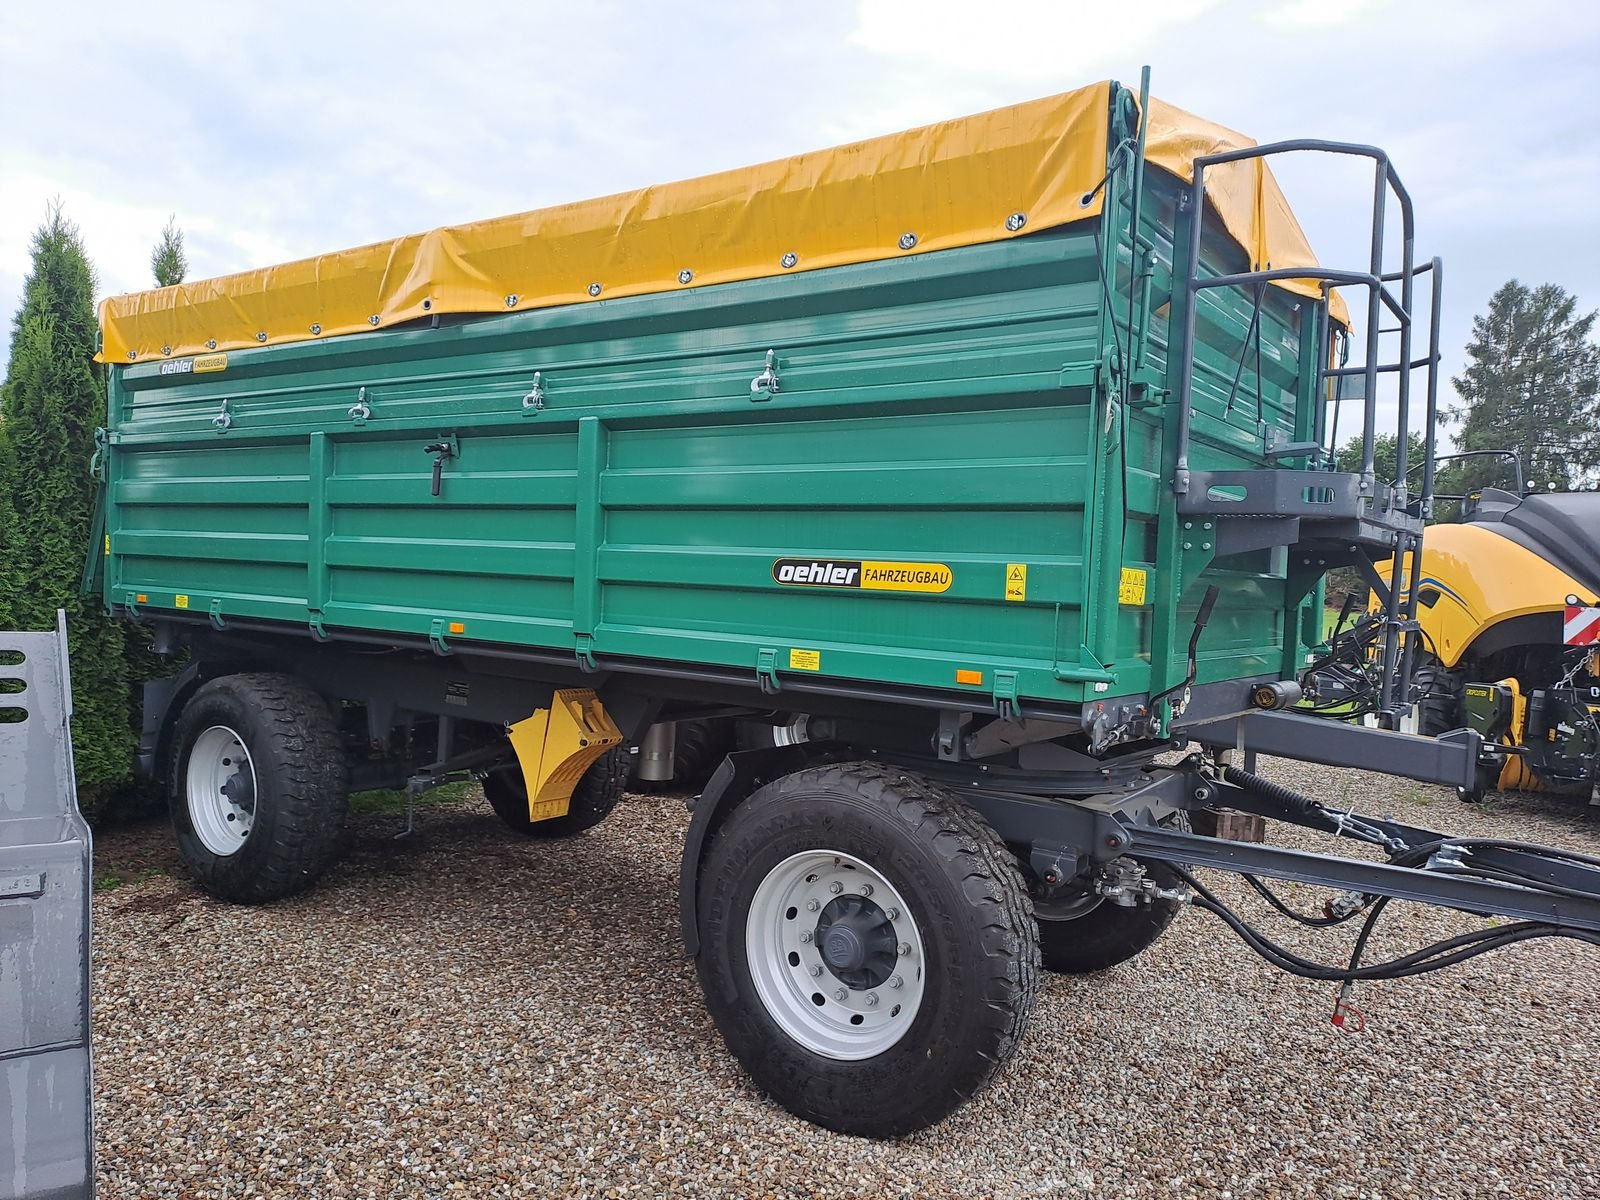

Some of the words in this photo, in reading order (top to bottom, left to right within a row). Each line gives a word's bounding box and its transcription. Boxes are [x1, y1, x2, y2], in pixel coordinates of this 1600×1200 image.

[161, 360, 193, 375] oehler
[194, 357, 226, 368] FAHRZEUGBAU
[778, 563, 859, 584] oehler
[864, 569, 949, 585] FAHRZEUGBAU
